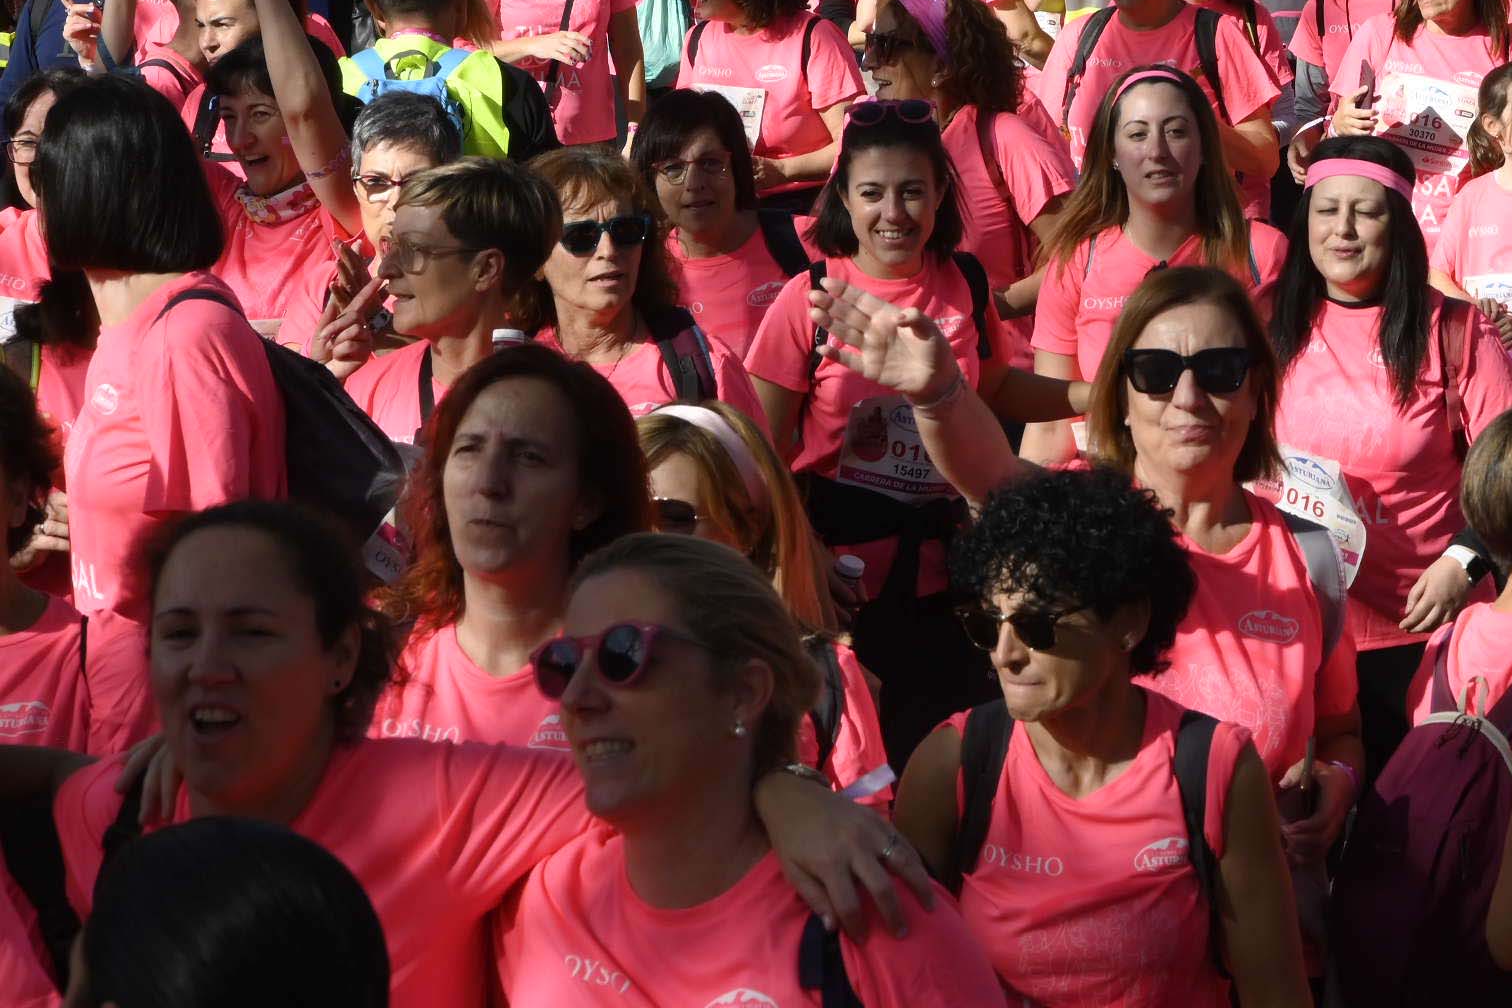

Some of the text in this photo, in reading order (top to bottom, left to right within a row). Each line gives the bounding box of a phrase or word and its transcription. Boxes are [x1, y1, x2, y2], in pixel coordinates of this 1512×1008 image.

[1408, 128, 1436, 142] 30370
[893, 463, 931, 480] 15497
[1288, 462, 1333, 487] ASTURIANA
[1286, 487, 1325, 518] 016
[0, 716, 48, 729] STURIANA
[983, 843, 1064, 877] OYSHO
